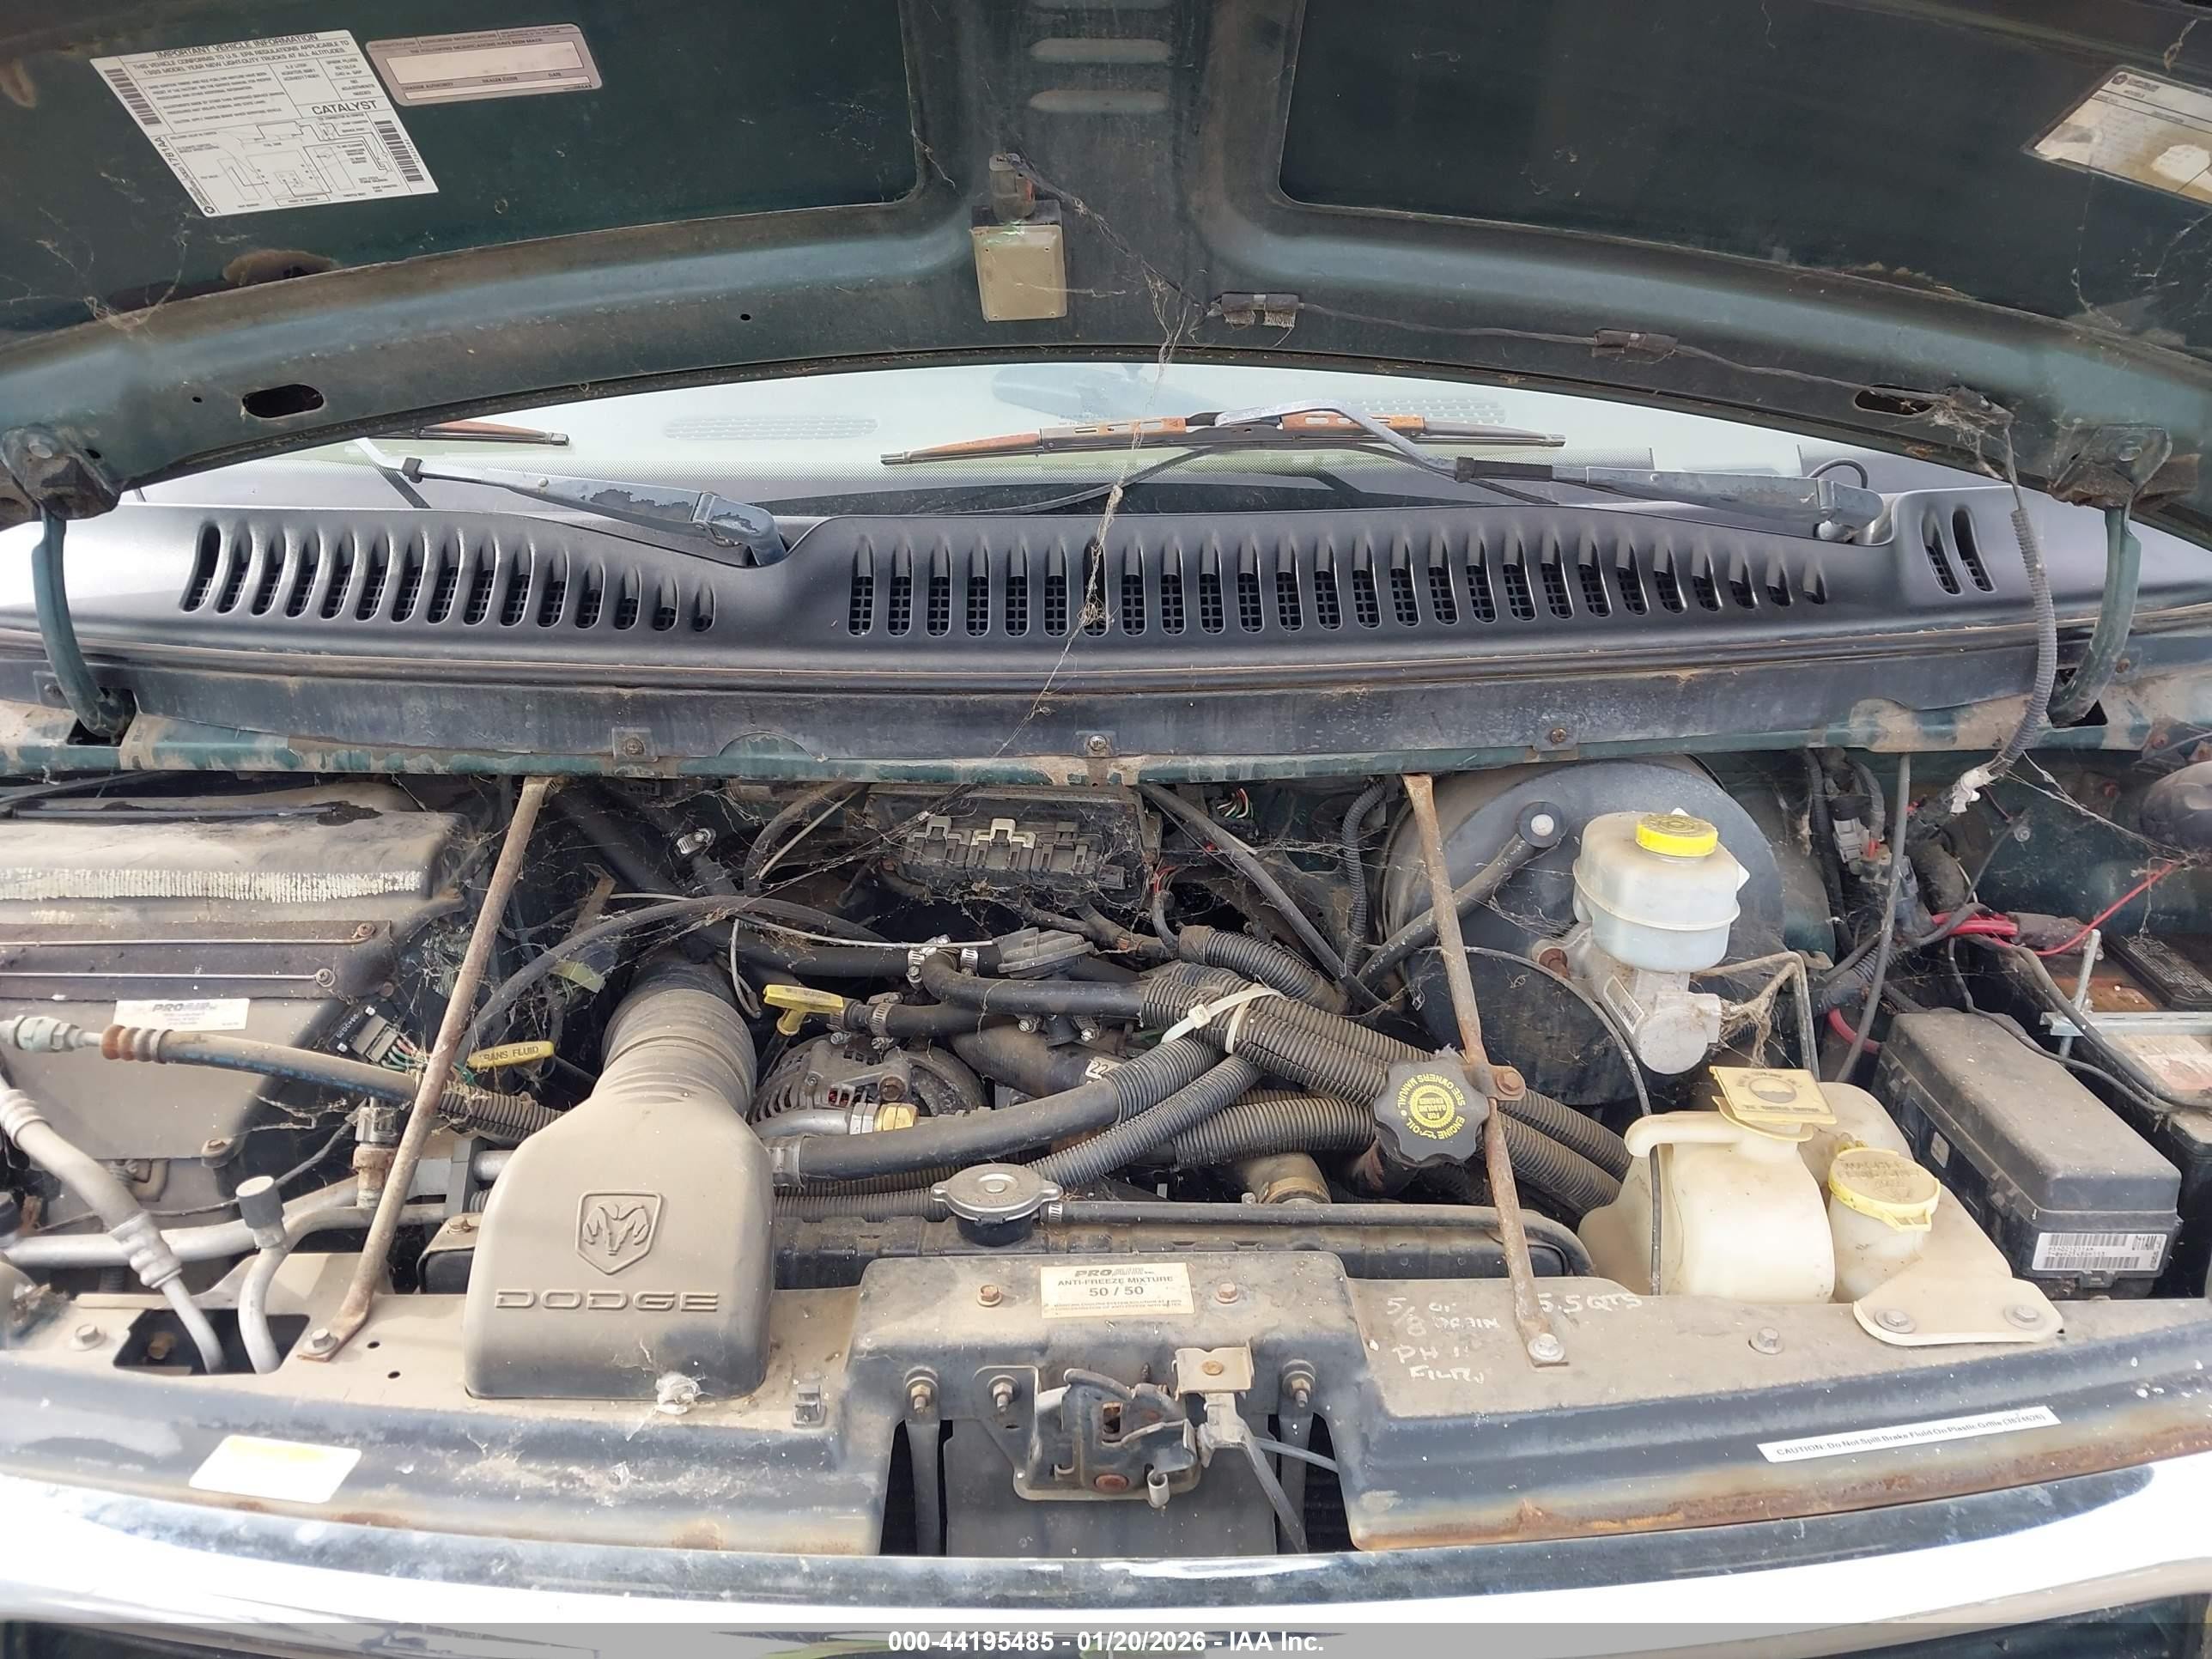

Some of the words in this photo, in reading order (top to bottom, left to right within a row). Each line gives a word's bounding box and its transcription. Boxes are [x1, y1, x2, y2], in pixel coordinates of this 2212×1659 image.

[155, 46, 210, 59] IMPORTANT
[212, 40, 251, 53] VEHICLE
[252, 33, 319, 49] INFORMATION
[311, 100, 379, 116] CATALYST
[512, 1045, 539, 1058] FLUID
[1416, 1073, 1455, 1090] OWNERS
[1397, 1077, 1419, 1109] MANUAL
[1450, 1086, 1466, 1107] SEE
[1406, 1117, 1421, 1133] OIL
[1437, 1115, 1466, 1139] ENGINE
[1057, 1277, 1125, 1286] ANTI-FREEZE
[1127, 1275, 1174, 1285] MIXTURE
[1089, 1286, 1109, 1297] 50
[1123, 1285, 1145, 1297] 50
[495, 1289, 719, 1313] DODGE
[1776, 1442, 1826, 1456] CAUTION:
[1826, 1441, 1842, 1450] Do
[1842, 1439, 1861, 1448] Not
[1861, 1436, 1882, 1446] Spill
[1883, 1433, 1909, 1443] Brake
[1910, 1429, 1934, 1439] Fluid
[1933, 1427, 1948, 1436] On
[1948, 1423, 1977, 1433] Plastic
